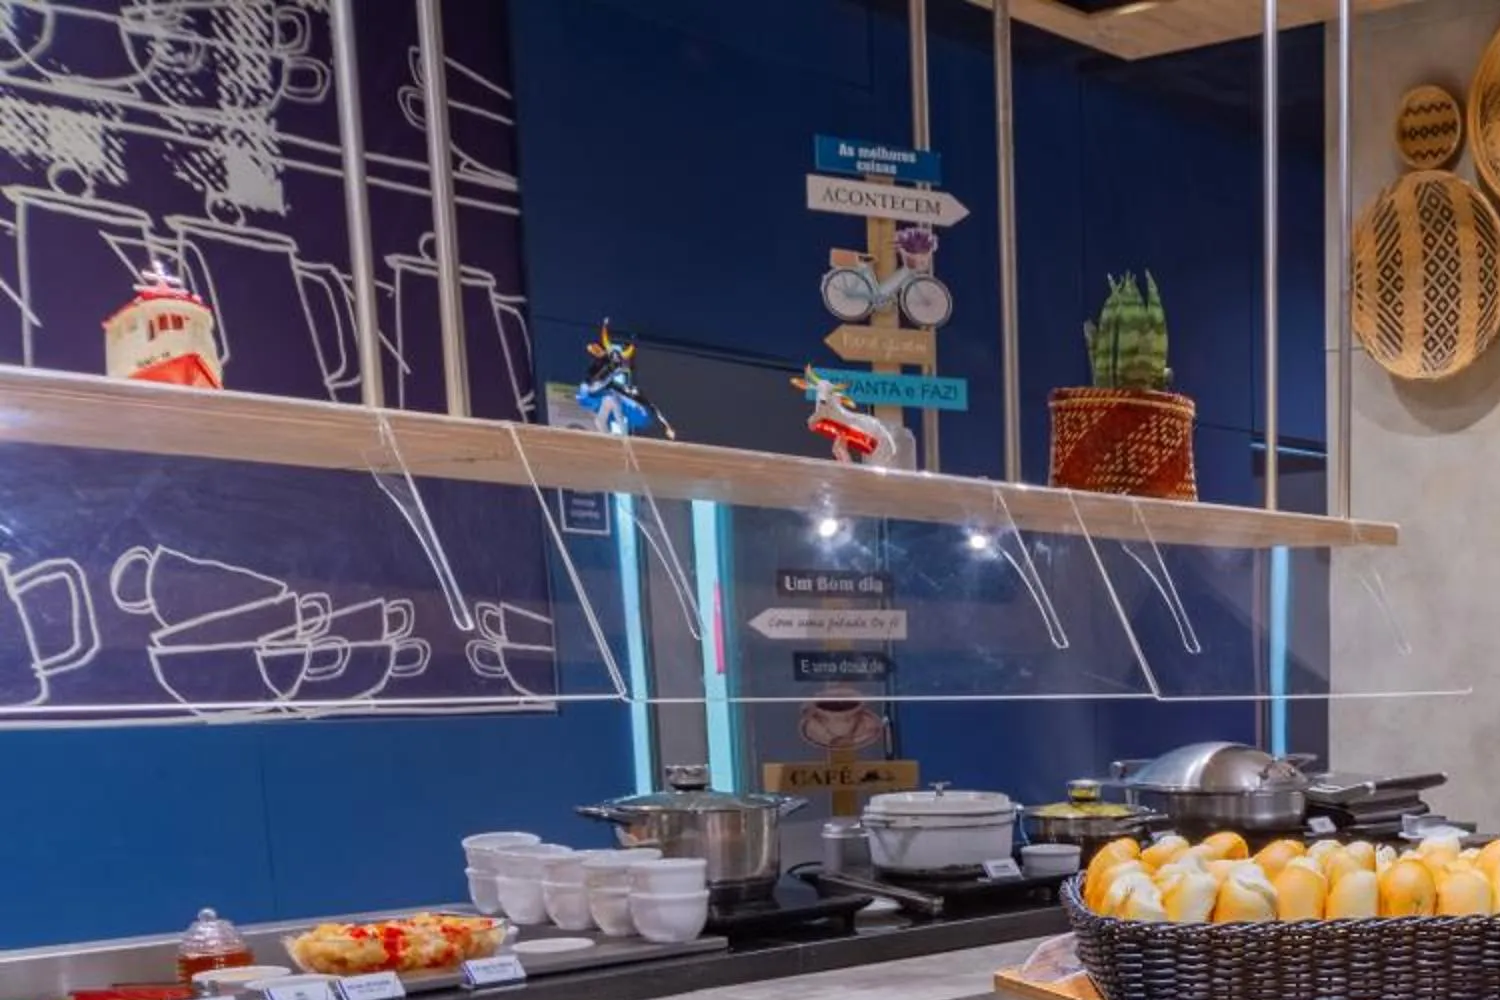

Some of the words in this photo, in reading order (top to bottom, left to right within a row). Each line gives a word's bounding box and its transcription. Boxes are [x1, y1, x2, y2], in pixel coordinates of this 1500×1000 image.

[822, 186, 942, 216] ACONTECEM
[784, 575, 812, 592] Um
[817, 575, 854, 592] Bom
[790, 764, 851, 786] CAFÉ
